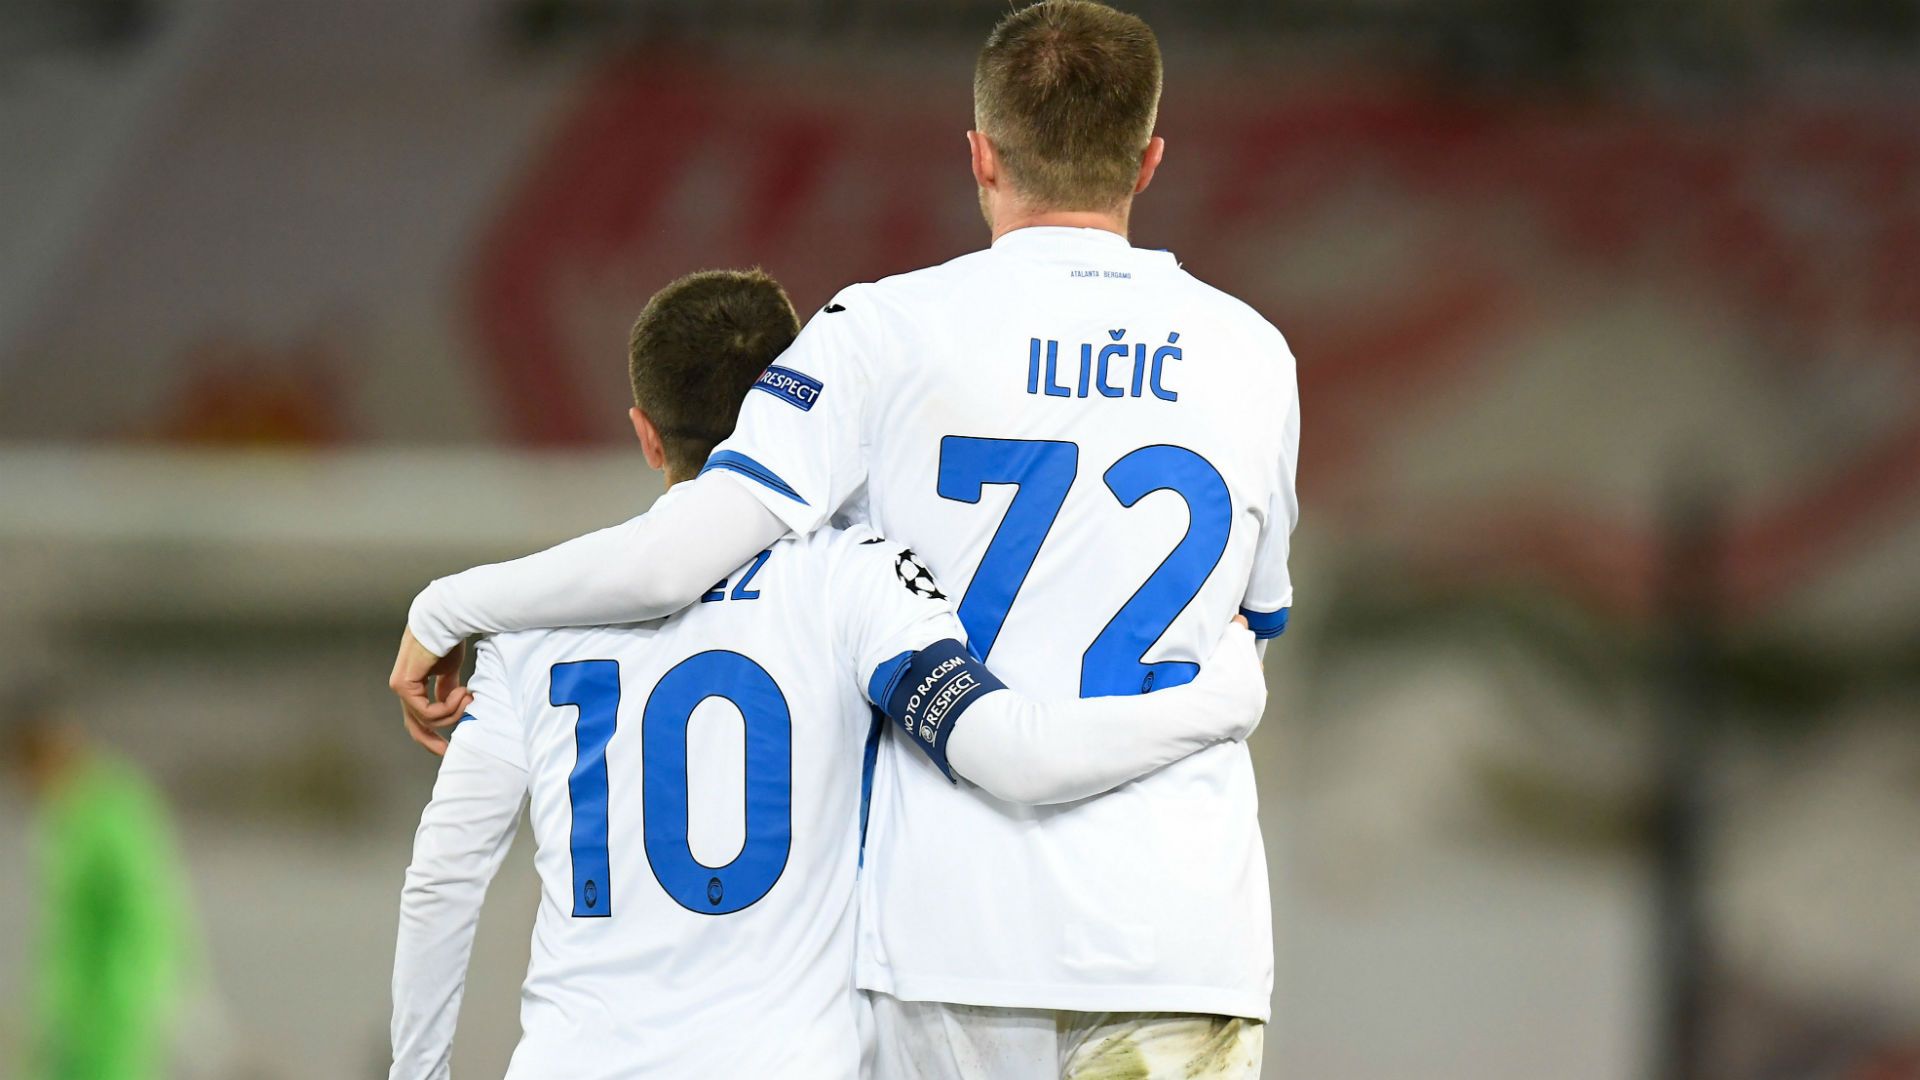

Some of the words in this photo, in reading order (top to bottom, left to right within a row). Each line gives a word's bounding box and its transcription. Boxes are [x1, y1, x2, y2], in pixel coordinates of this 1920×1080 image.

[1070, 270, 1099, 278] ATALANTA
[1103, 270, 1131, 279] BERGAMO
[1027, 328, 1183, 402] ILIČIĆ
[760, 371, 818, 403] RESPECT
[937, 435, 1233, 699] 72
[917, 656, 966, 696] RACISM
[906, 694, 920, 714] TO
[926, 673, 975, 726] RESPECT
[904, 715, 914, 735] NO
[549, 649, 792, 918] 10
